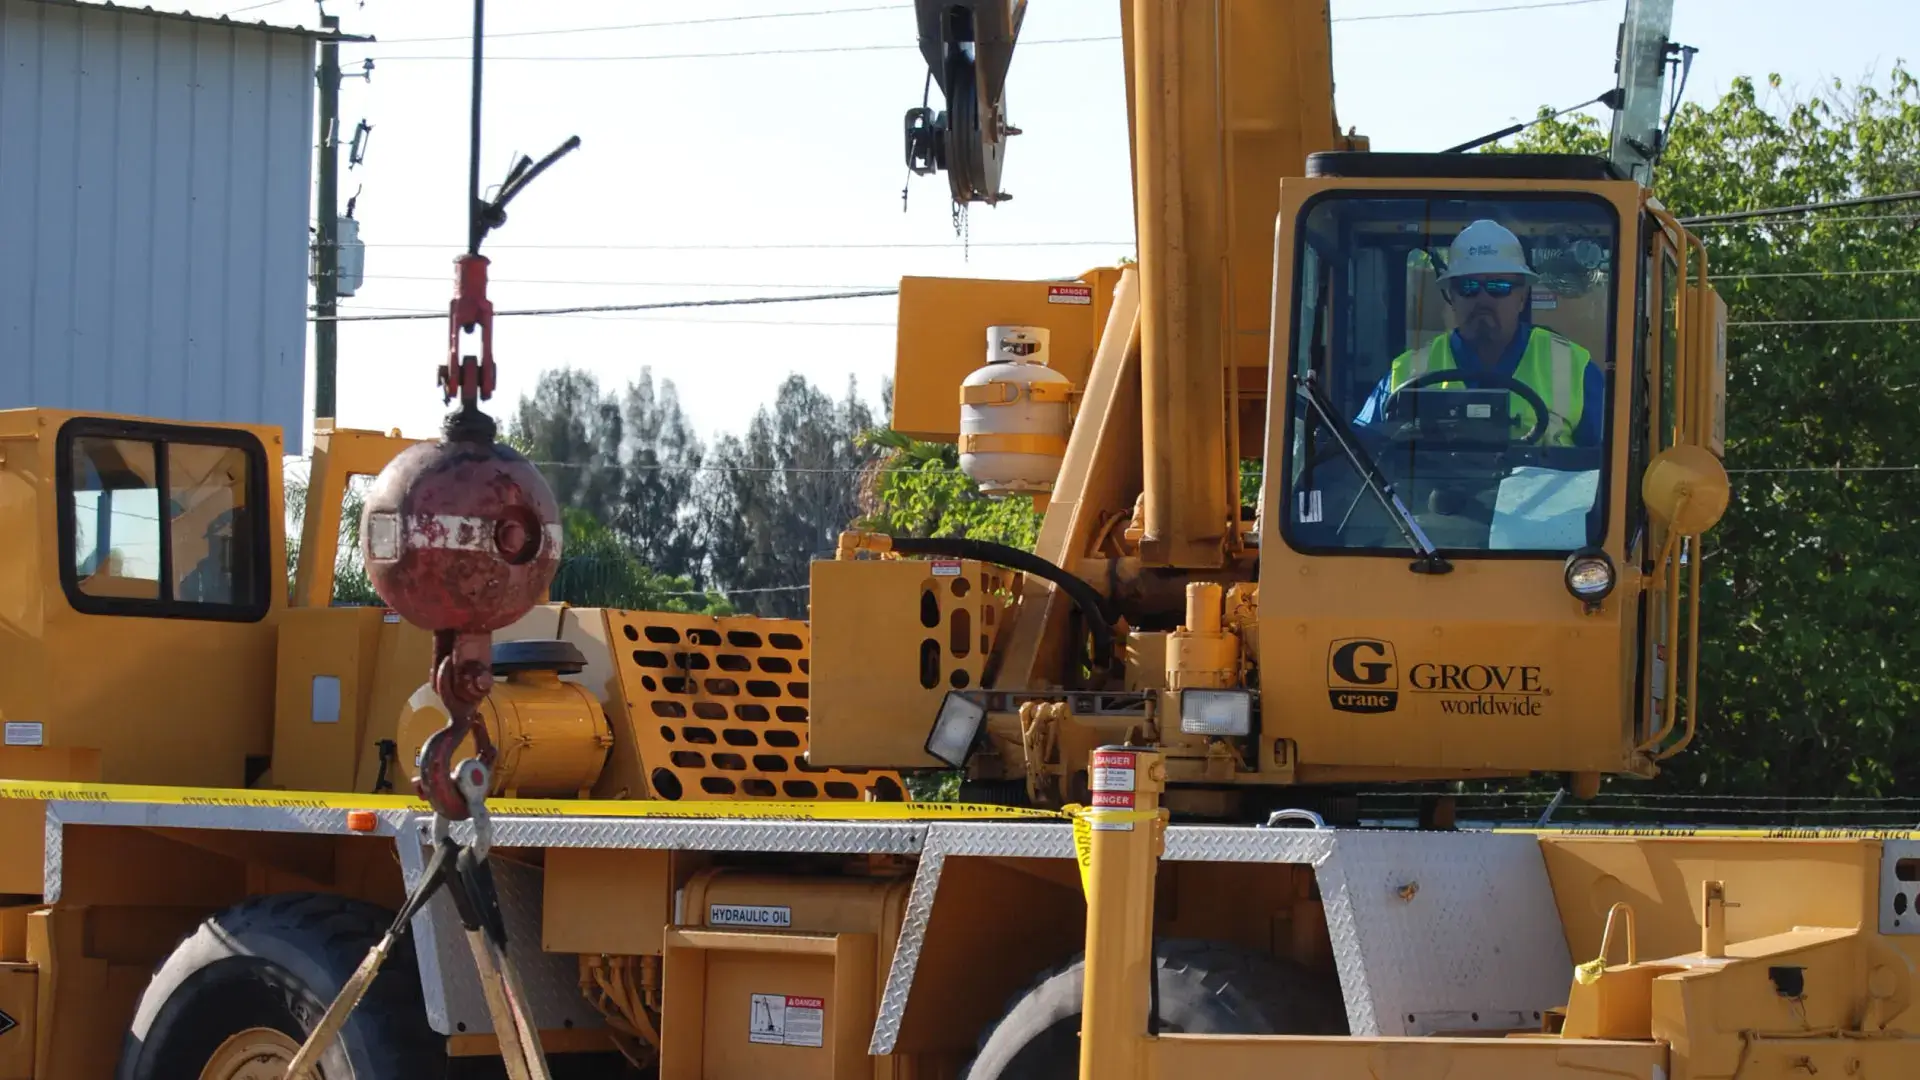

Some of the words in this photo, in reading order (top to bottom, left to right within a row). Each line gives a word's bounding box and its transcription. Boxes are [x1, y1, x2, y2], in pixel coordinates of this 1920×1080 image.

[1332, 641, 1392, 685] G
[1408, 663, 1542, 692] GROVE
[1338, 692, 1389, 708] crane
[1440, 695, 1542, 716] worldwide
[1096, 756, 1130, 765] DANGER
[712, 908, 769, 922] HYDRAULIC
[772, 911, 788, 923] OIL
[795, 998, 821, 1006] DANGER
